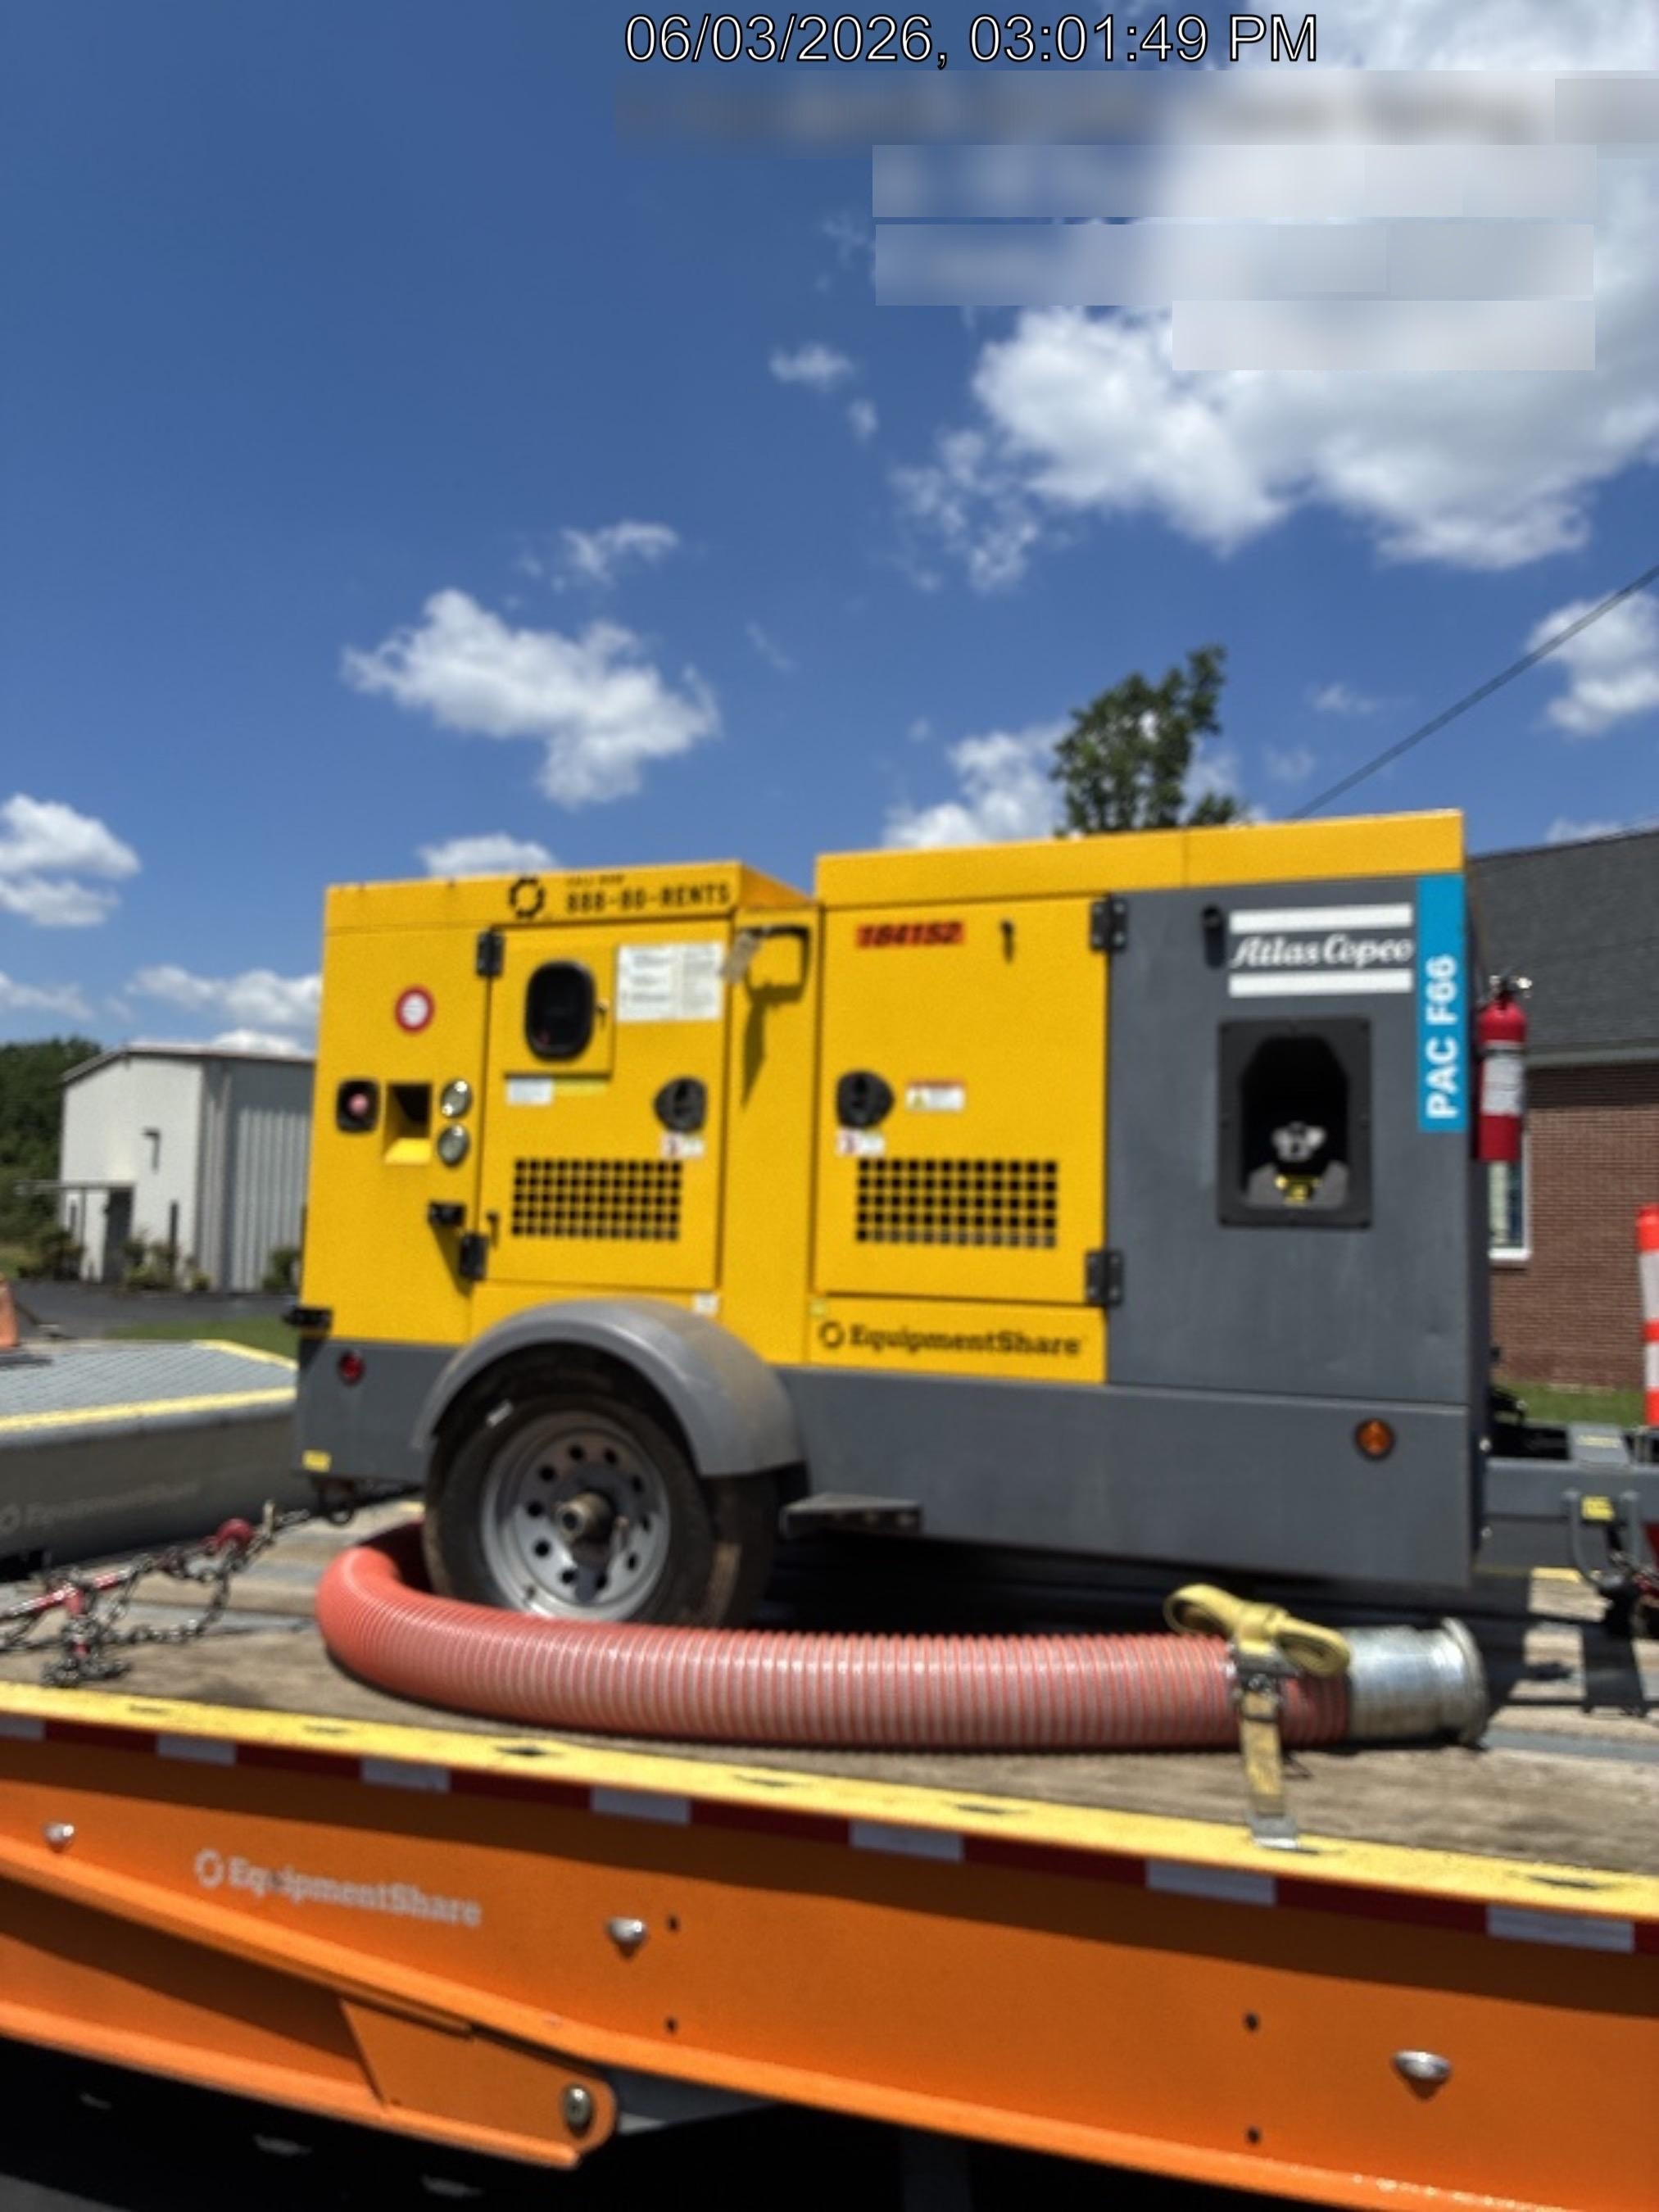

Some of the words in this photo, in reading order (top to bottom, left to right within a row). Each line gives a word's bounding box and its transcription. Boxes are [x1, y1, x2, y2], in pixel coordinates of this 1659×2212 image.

[1232, 935, 1317, 968] Atlas
[1323, 932, 1415, 968] Copco
[1425, 954, 1459, 1026] F66
[1425, 1036, 1459, 1119] PAC
